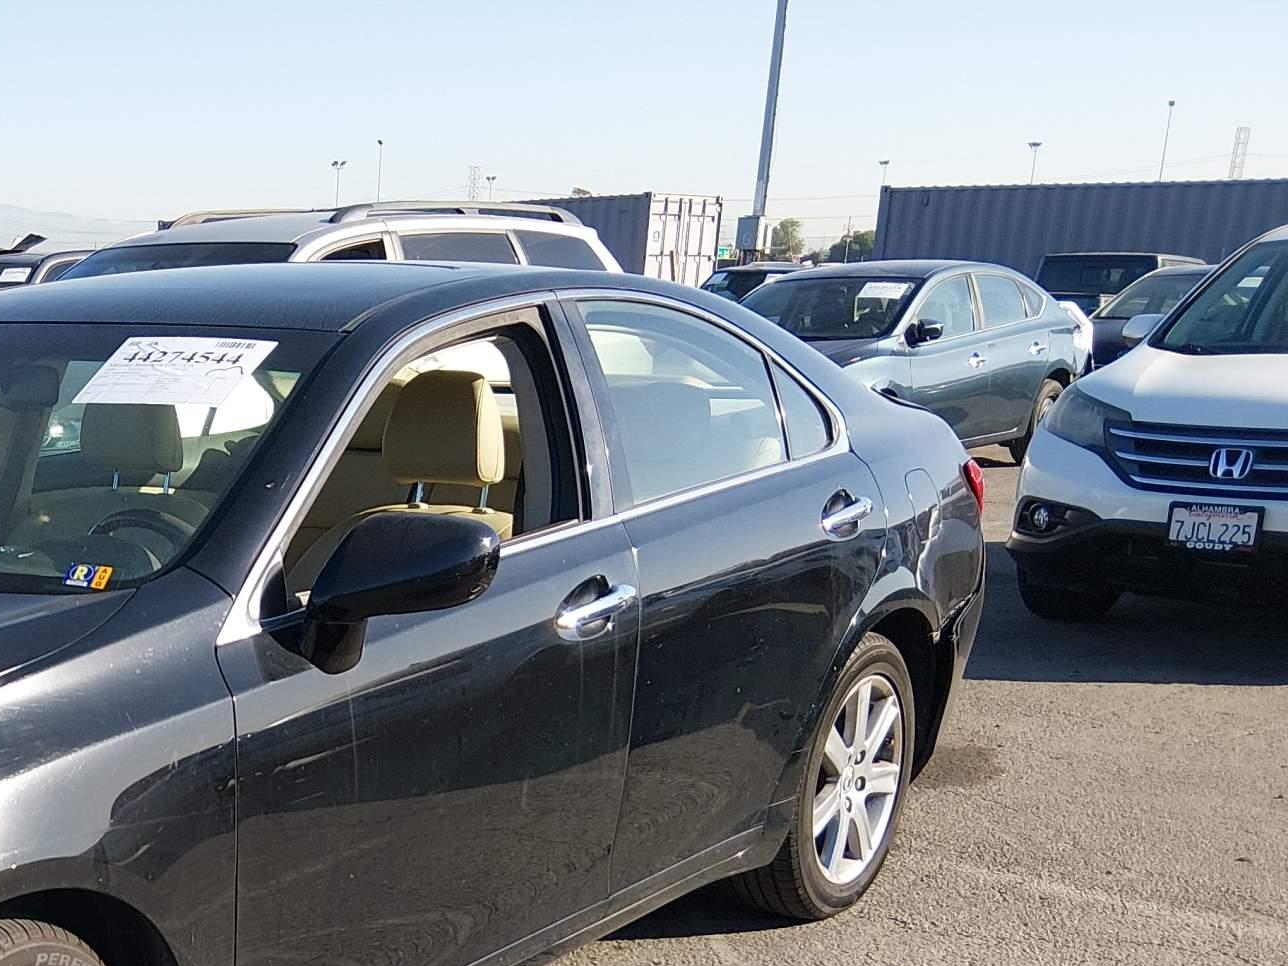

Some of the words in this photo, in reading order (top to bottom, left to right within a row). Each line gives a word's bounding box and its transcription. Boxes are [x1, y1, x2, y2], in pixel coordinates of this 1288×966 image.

[123, 351, 244, 365] 44274544
[1191, 505, 1241, 514] ALHAMBRA
[1175, 520, 1252, 544] 7JCL225
[72, 565, 89, 580] R
[94, 567, 108, 587] AUG
